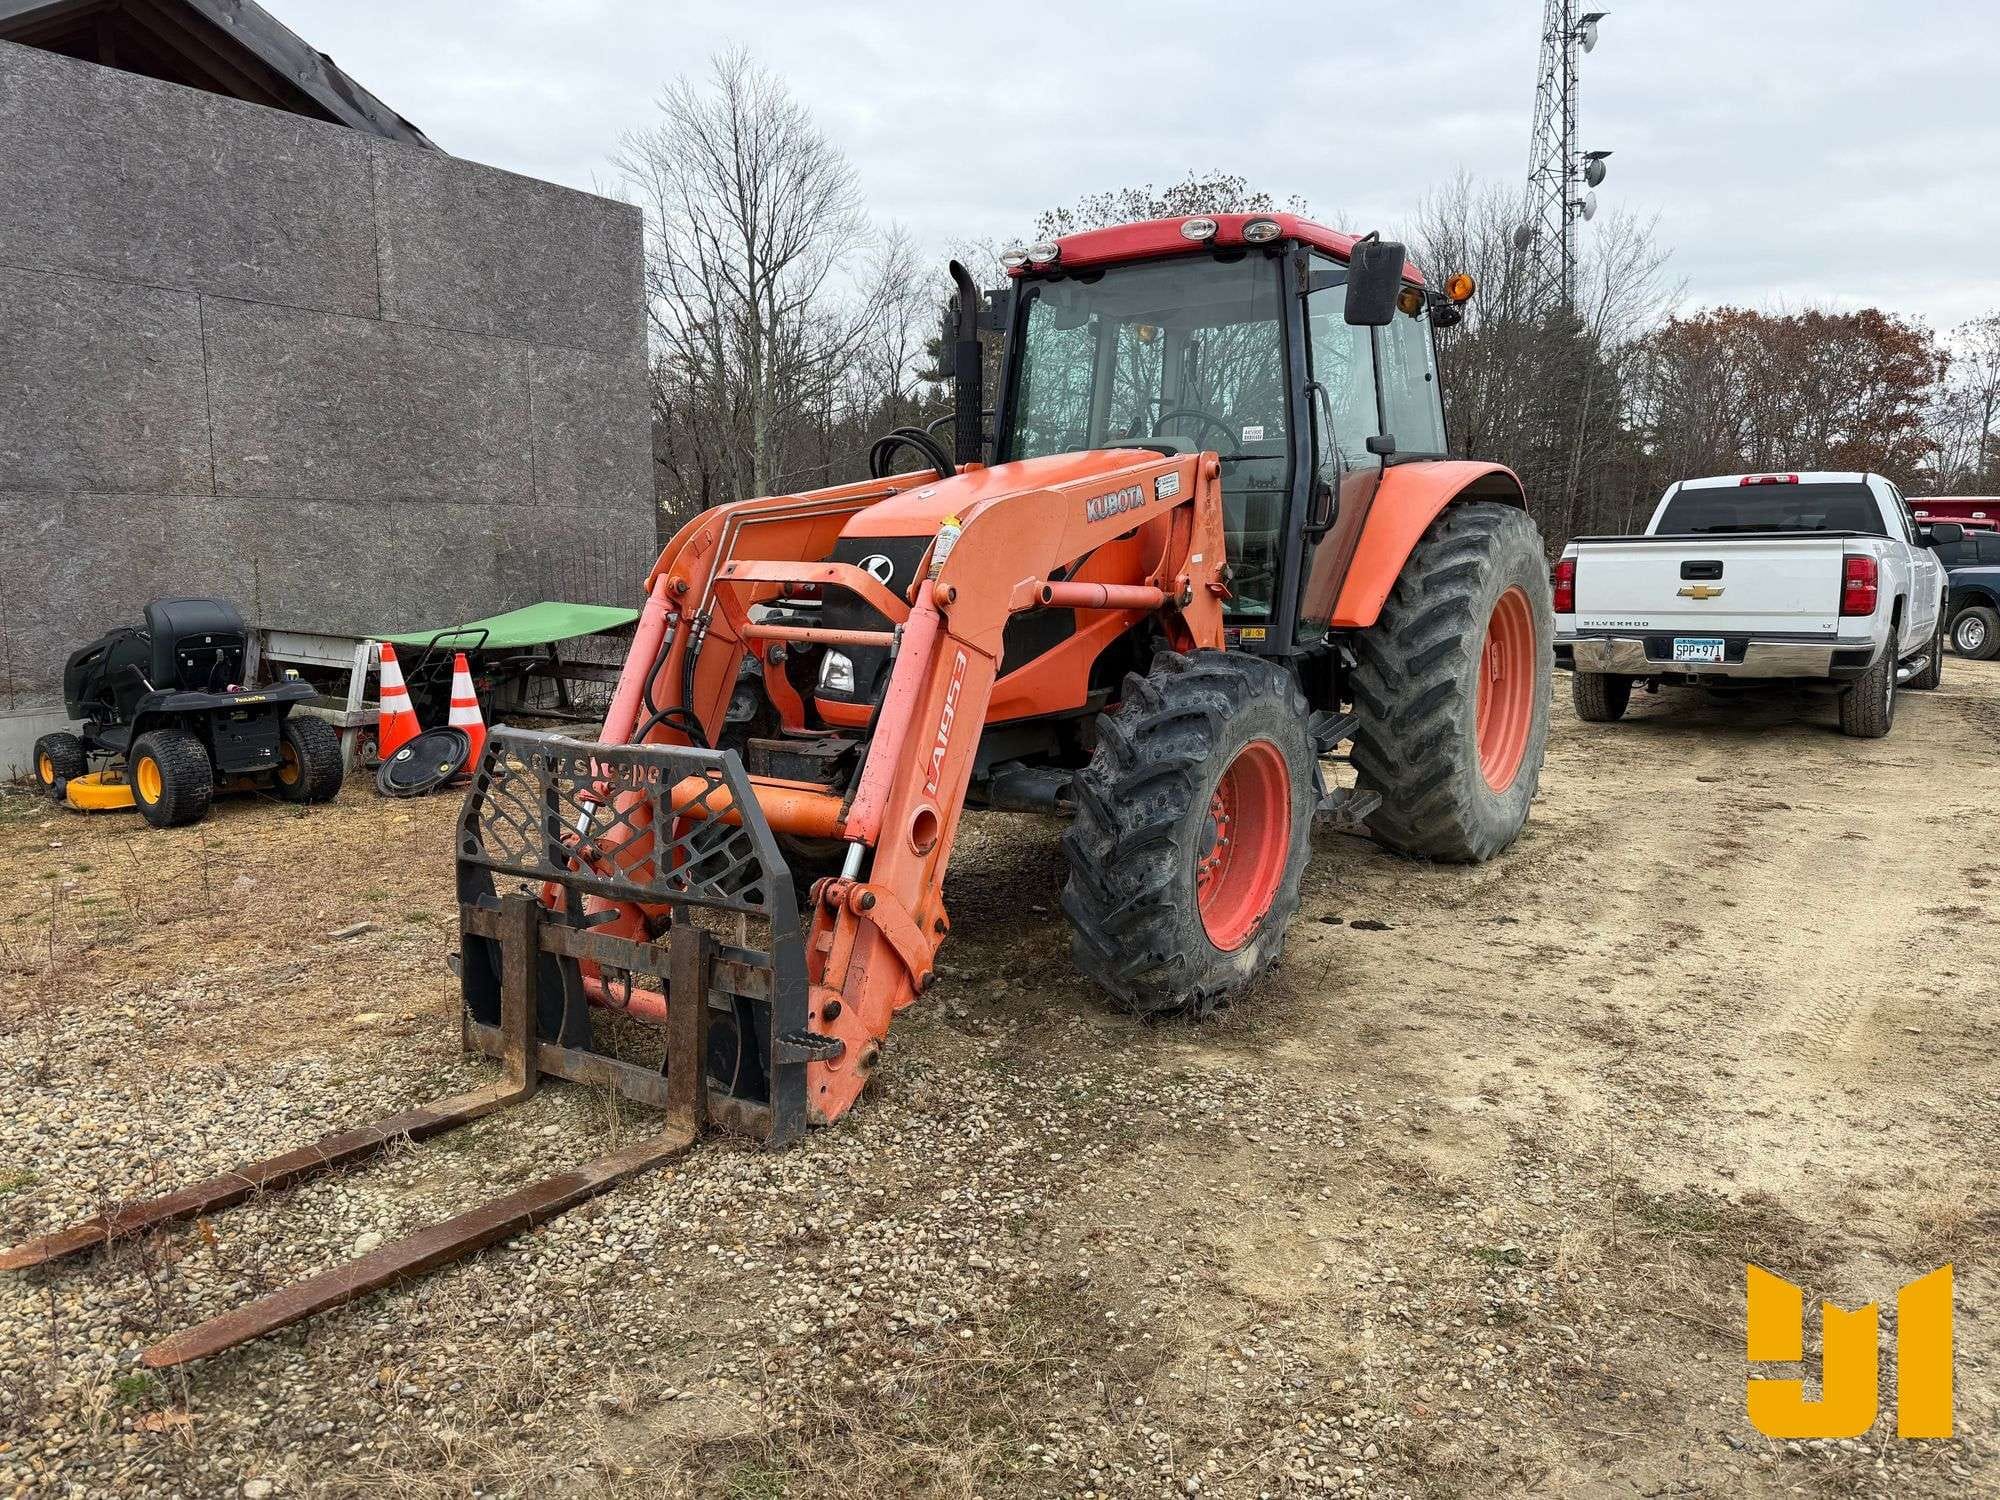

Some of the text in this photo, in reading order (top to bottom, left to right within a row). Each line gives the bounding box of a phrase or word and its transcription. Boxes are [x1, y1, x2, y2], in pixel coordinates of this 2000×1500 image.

[1086, 483, 1145, 523] KUBOTA
[1676, 644, 1720, 657] SPP 971
[926, 650, 967, 795] LA1953
